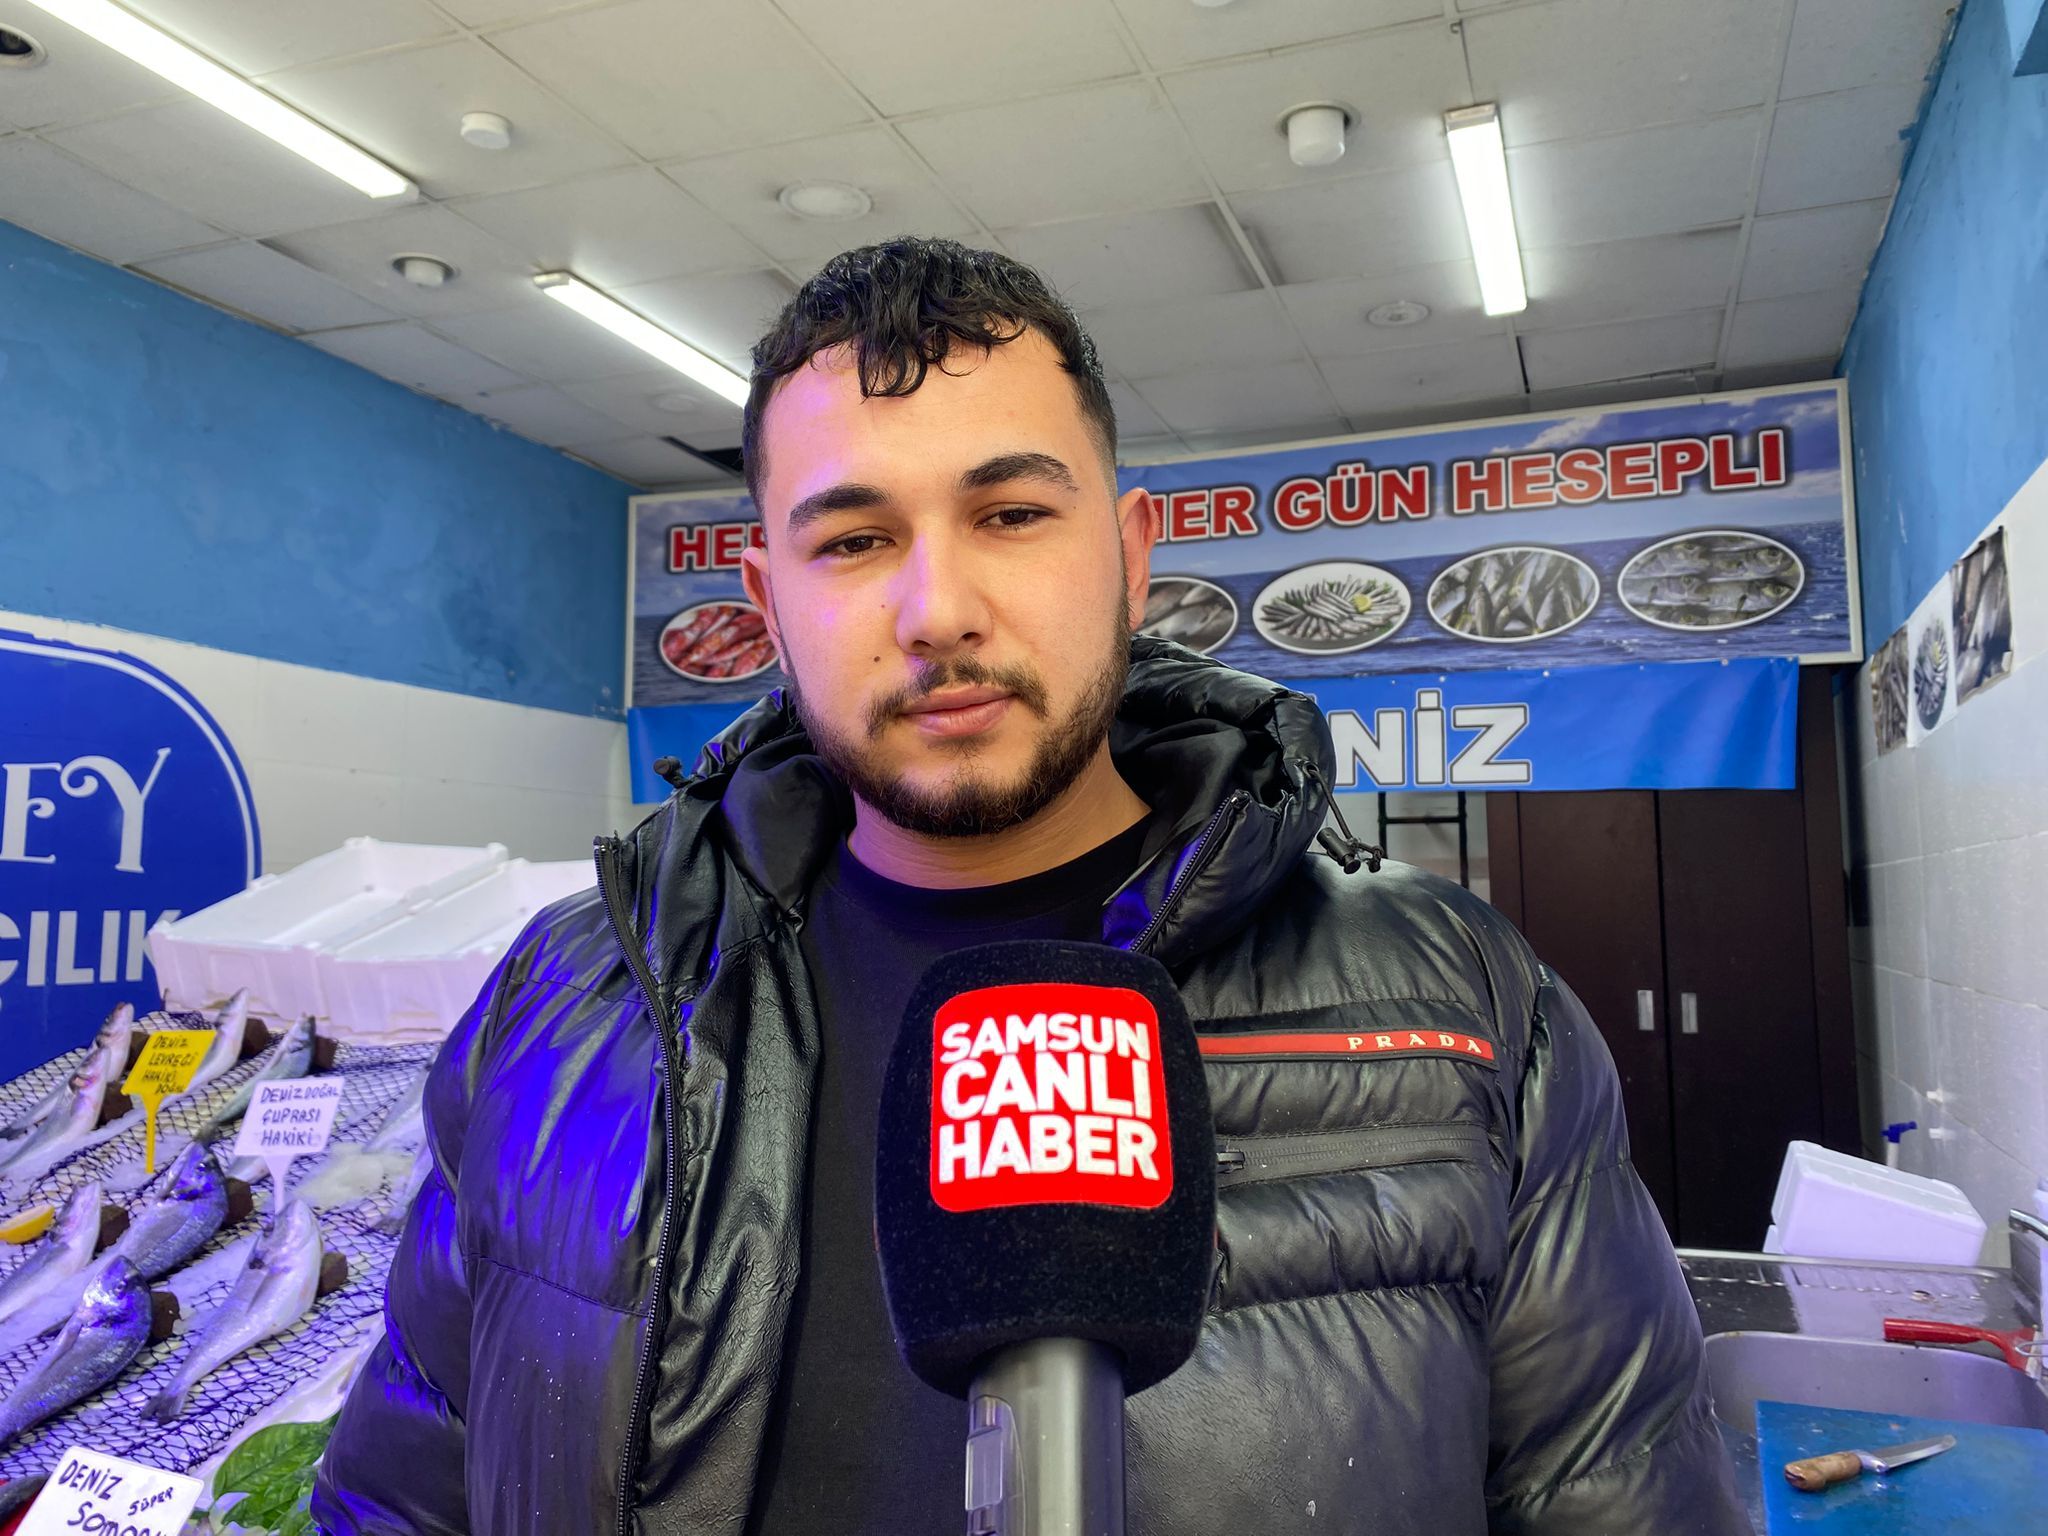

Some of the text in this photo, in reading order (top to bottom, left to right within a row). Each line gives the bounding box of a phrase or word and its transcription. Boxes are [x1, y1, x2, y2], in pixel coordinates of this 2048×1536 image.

[1273, 462, 1430, 531] GÜN
[1453, 429, 1786, 514] HESEPLI
[940, 1012, 1151, 1064] SAMSUN
[1347, 1033, 1482, 1054] PRADA
[260, 1082, 340, 1104] DENİZ DOĞAL
[941, 1051, 1152, 1120] CANLI
[262, 1107, 321, 1125] ÇUPRASI
[261, 1126, 316, 1146] HAKİKİ
[938, 1114, 1160, 1184] HABER
[58, 1459, 122, 1501] DENİZ
[127, 1486, 174, 1516] SÜPER
